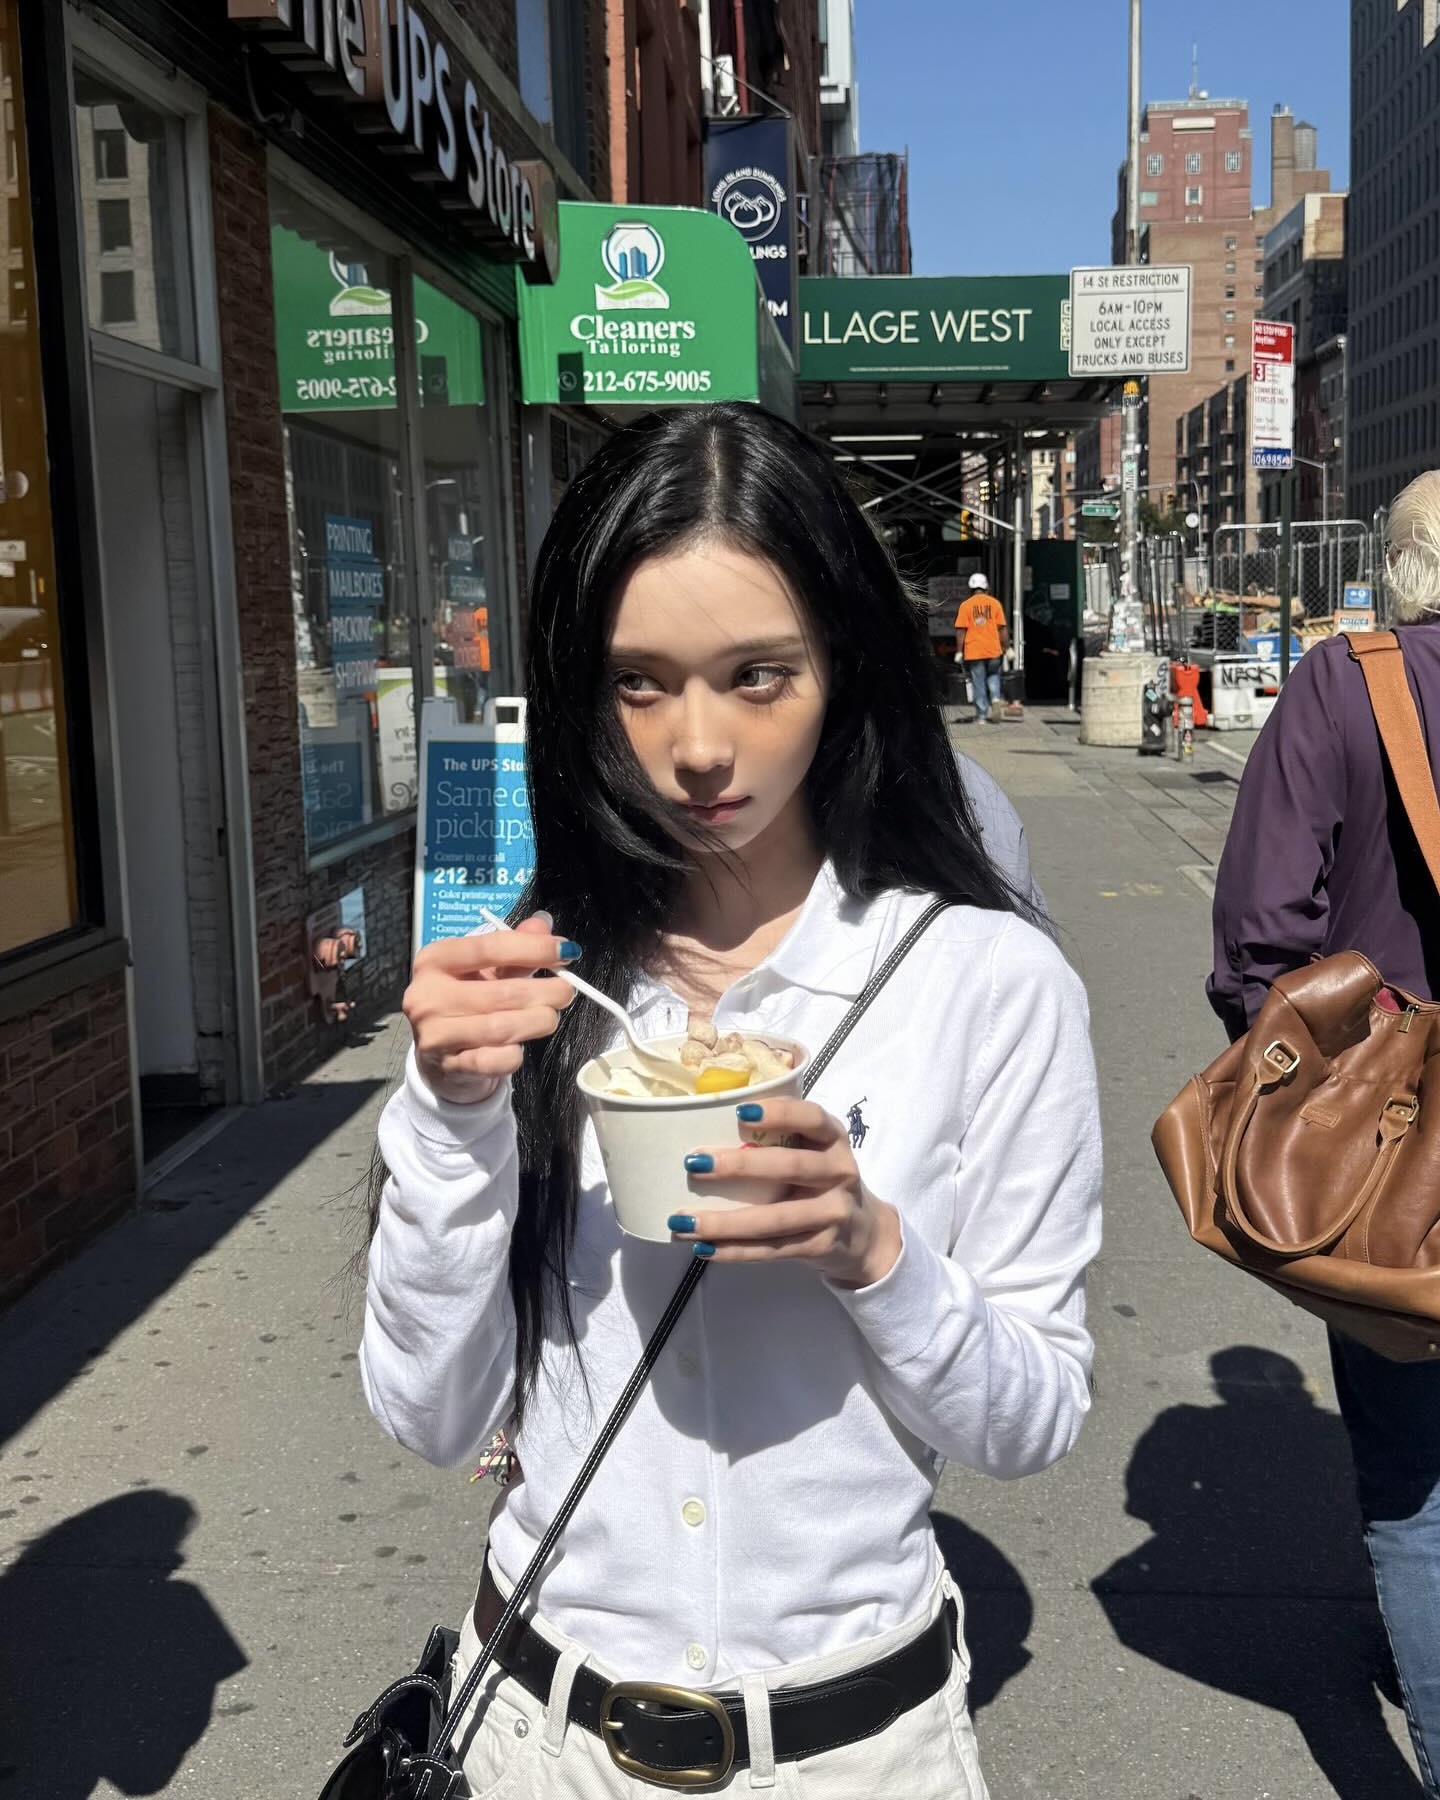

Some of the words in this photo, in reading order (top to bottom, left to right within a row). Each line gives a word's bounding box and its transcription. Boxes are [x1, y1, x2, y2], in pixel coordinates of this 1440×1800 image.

[380, 0, 457, 181] UPS
[464, 78, 536, 262] Store
[1083, 276, 1094, 288] 14
[1098, 276, 1109, 288] St
[1112, 273, 1179, 288] RESTRICTION
[570, 314, 696, 340] Cleaners
[804, 310, 920, 344] LLAGE
[930, 309, 1032, 343] WEST
[1090, 320, 1125, 332] LOCAL
[1129, 318, 1170, 331] ACCESS
[586, 339, 680, 358] Tailoring
[1094, 336, 1121, 349] ONLY
[1126, 335, 1166, 348] EXCEPT
[1077, 354, 1117, 366] TRUCKS
[1121, 353, 1143, 365] AND
[1148, 352, 1183, 364] BUSES
[583, 370, 711, 392] 212-675-9005
[1256, 364, 1264, 380] 3
[326, 523, 373, 554] PRINTING
[330, 569, 384, 598] MAILBOXES
[332, 616, 374, 644] PACKING
[335, 659, 378, 689] SHIPPING
[443, 758, 467, 771] The
[471, 757, 498, 771] UPS
[502, 757, 529, 772] Sto
[436, 781, 508, 807] Same
[436, 812, 534, 846] pickups
[434, 851, 463, 862] Come
[488, 851, 506, 862] call
[438, 889, 460, 900] Color
